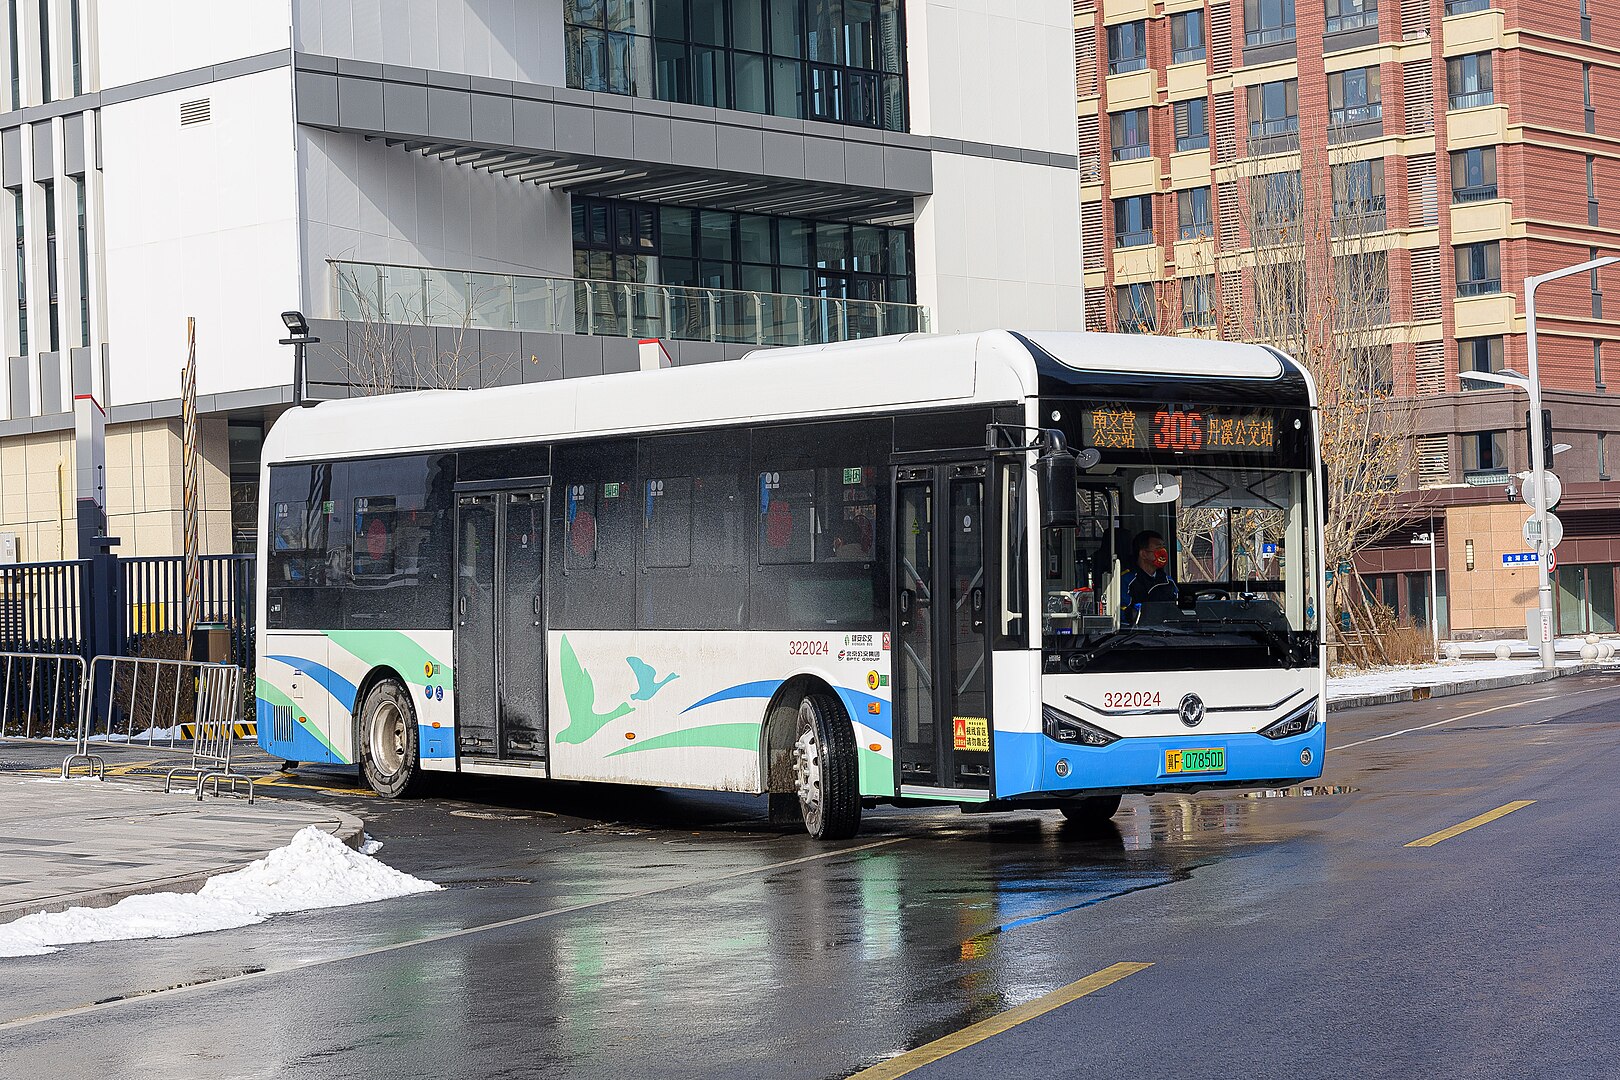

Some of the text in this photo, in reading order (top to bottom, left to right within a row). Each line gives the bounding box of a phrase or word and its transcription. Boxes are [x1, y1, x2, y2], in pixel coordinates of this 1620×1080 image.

[1092, 410, 1136, 430] 南文营
[1092, 430, 1136, 449] 公交站
[1154, 411, 1202, 450] 306
[1207, 418, 1273, 447] 丹溪公交站
[790, 641, 829, 655] 322024
[1104, 692, 1161, 708] 322024
